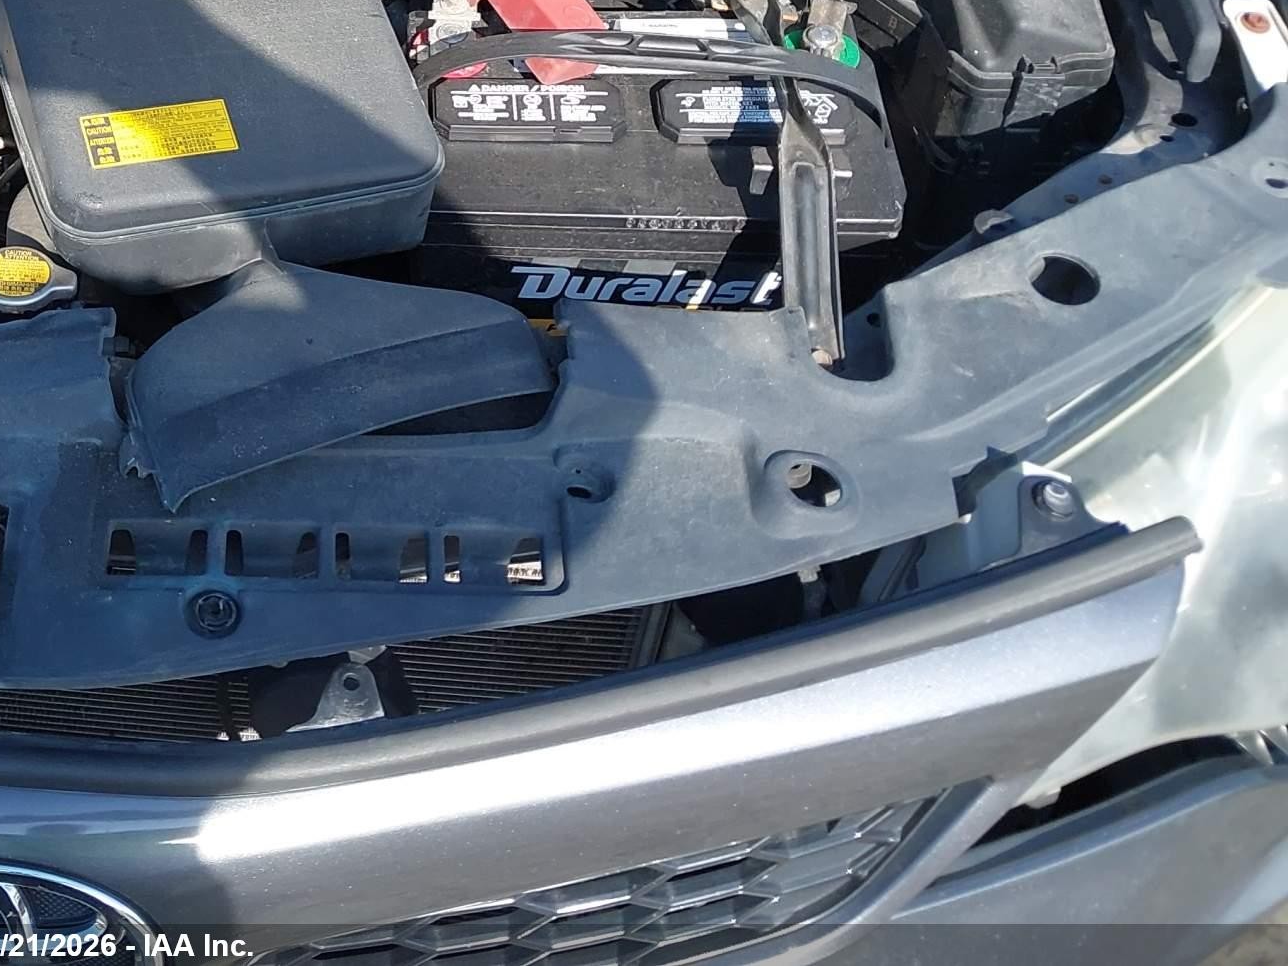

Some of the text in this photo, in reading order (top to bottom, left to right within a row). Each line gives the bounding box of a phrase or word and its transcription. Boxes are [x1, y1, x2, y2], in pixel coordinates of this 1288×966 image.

[481, 84, 529, 92] DANGER
[540, 85, 585, 93] POISON
[511, 265, 782, 306] Duralast
